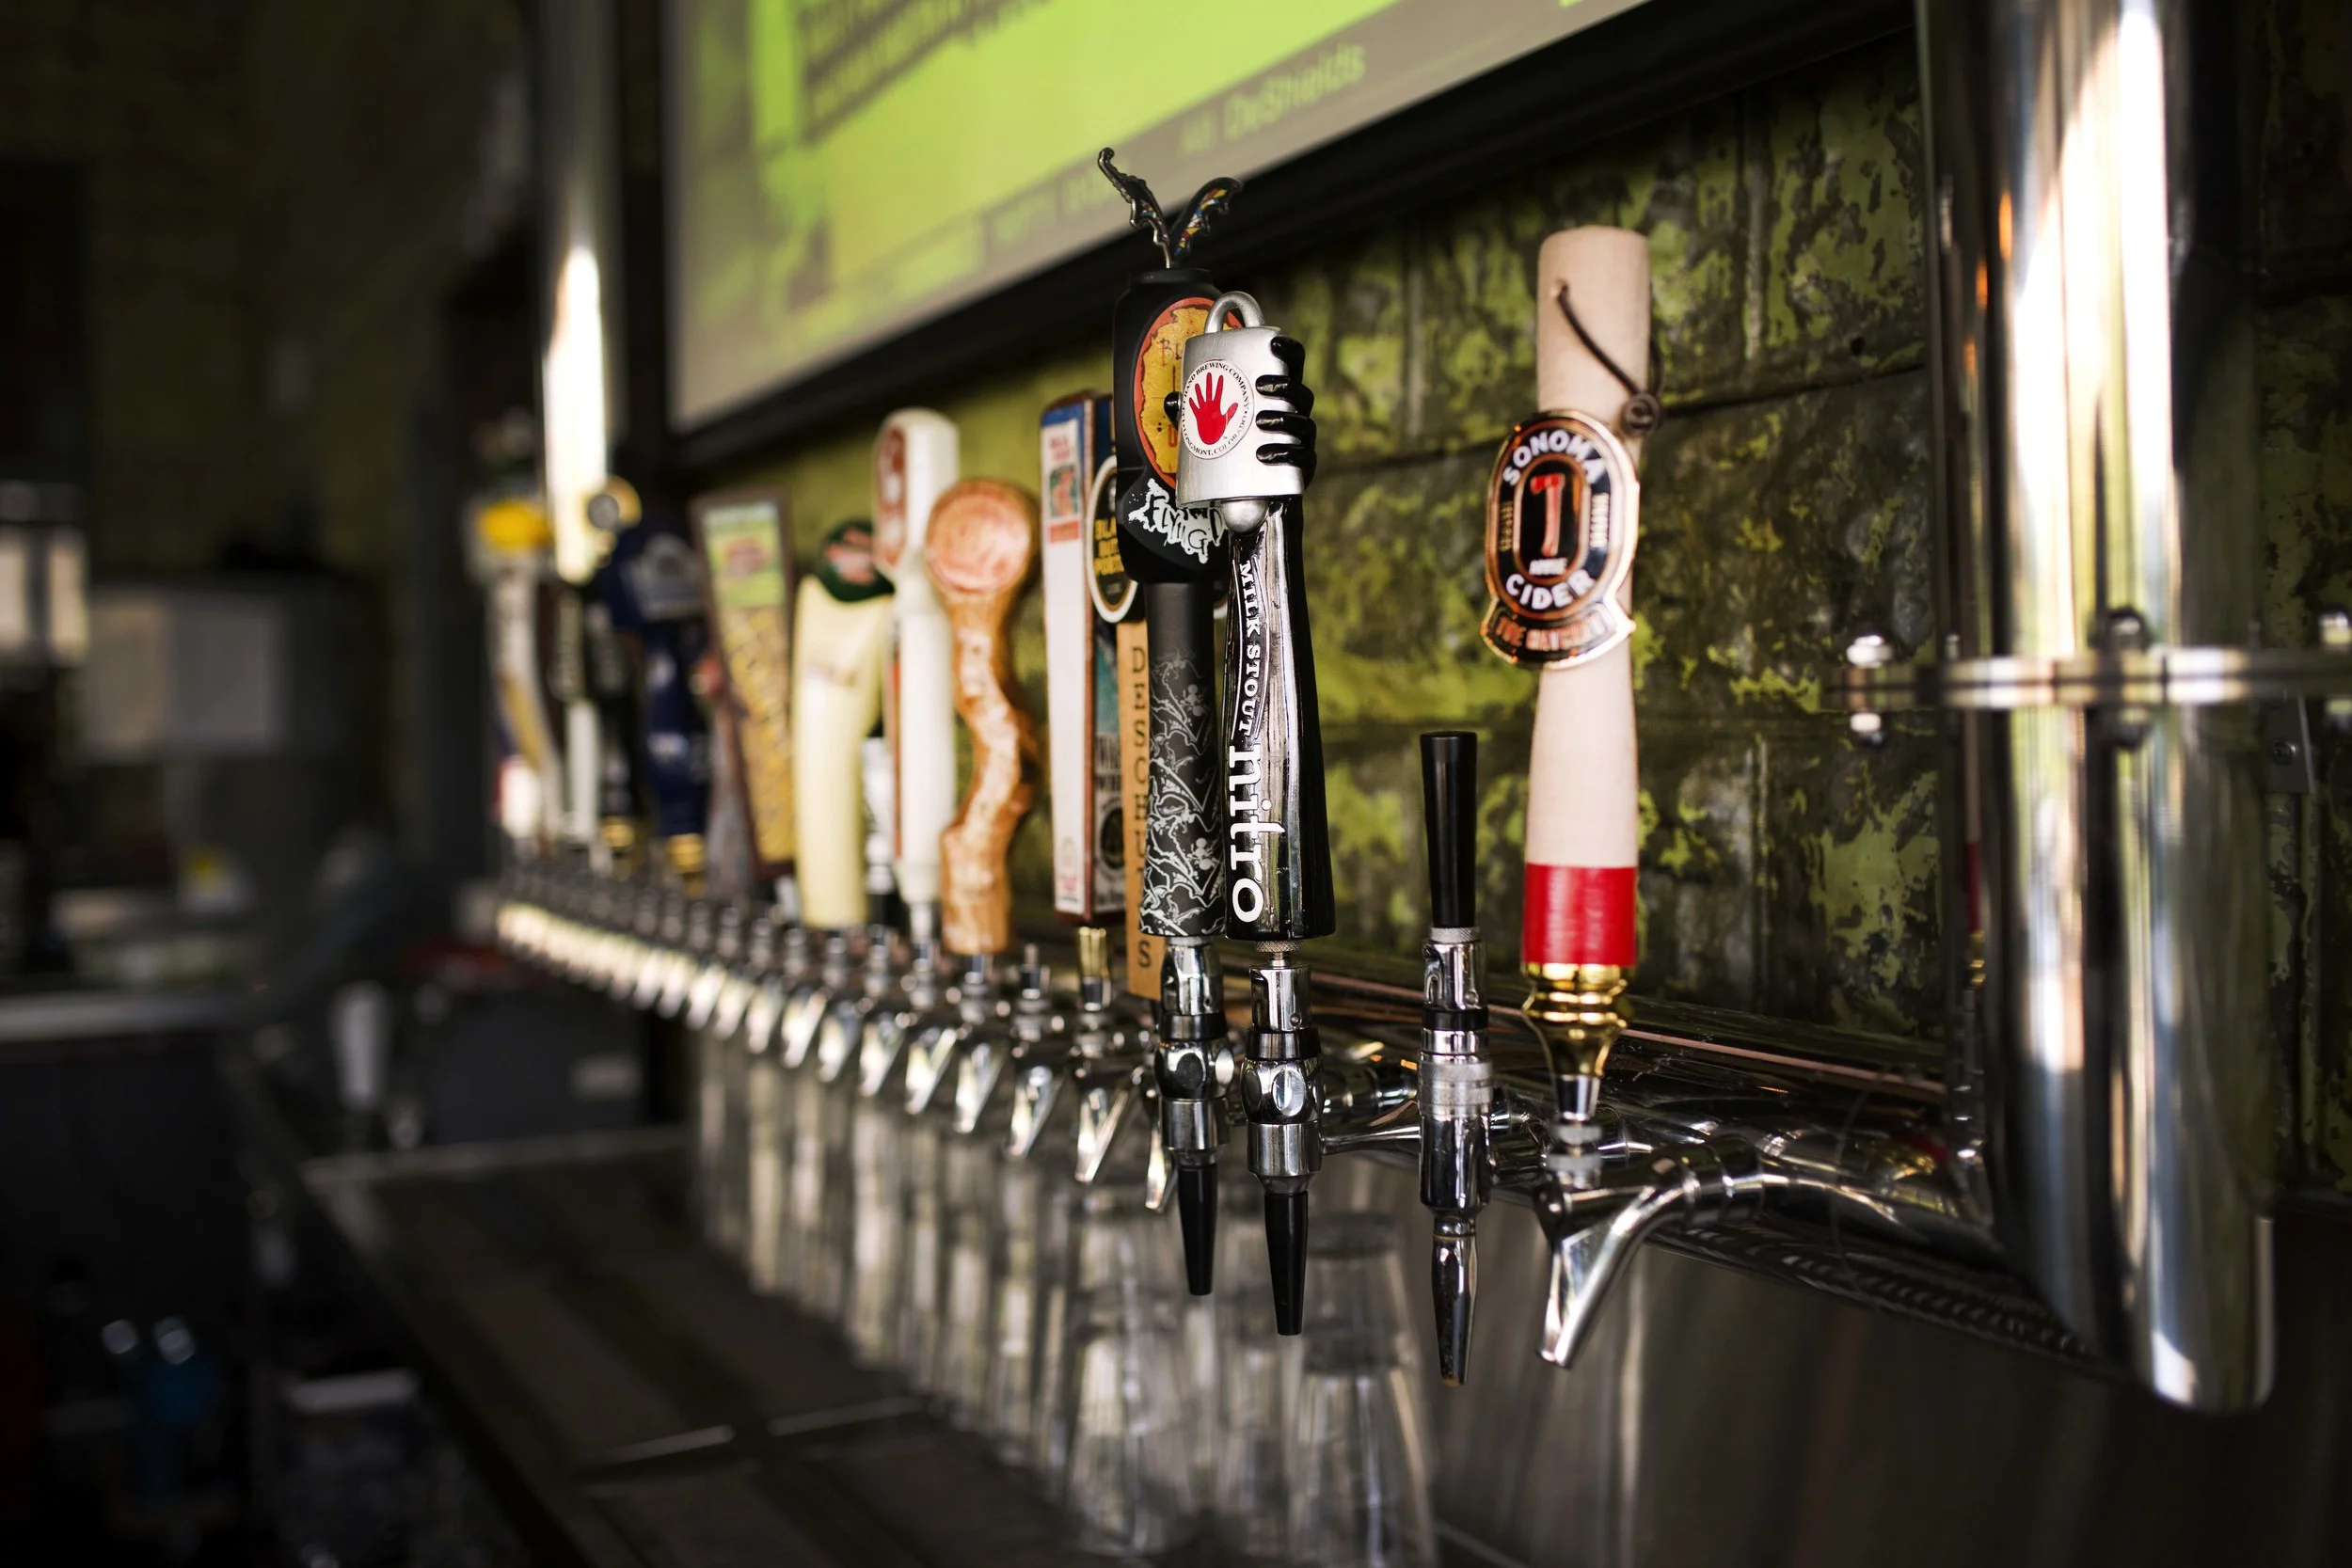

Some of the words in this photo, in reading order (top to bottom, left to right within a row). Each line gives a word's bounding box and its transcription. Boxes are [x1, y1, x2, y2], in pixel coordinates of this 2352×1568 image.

[1196, 362, 1229, 376] BREWING
[1229, 368, 1250, 410] COMPANY
[1503, 428, 1605, 486] SONOMA
[1239, 560, 1261, 639] MILK
[1505, 568, 1595, 610] CIDER
[1239, 644, 1261, 736] STOUT
[1229, 743, 1285, 923] nitro
